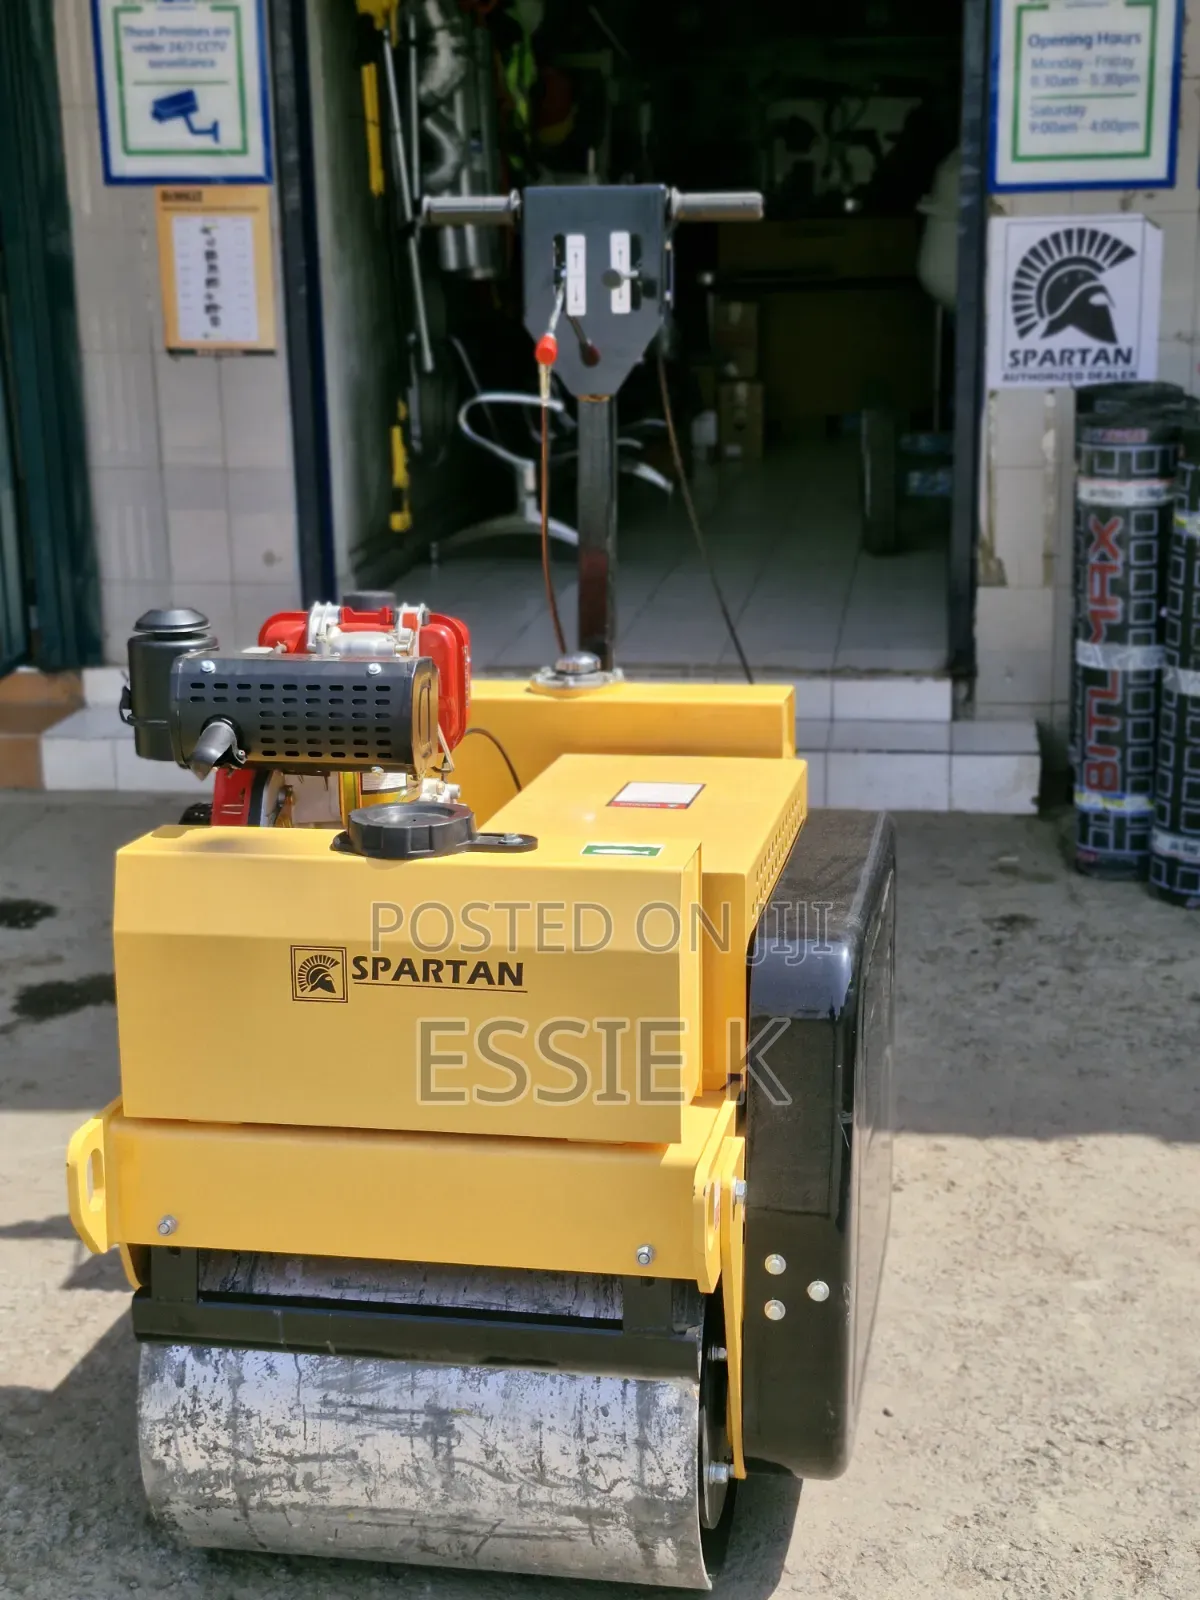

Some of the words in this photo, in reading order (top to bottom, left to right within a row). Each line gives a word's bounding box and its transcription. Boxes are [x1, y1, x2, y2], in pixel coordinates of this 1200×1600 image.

[1029, 34, 1093, 50] Opening
[1097, 32, 1141, 44] Hours
[1031, 58, 1083, 70] Monday
[1095, 56, 1135, 69] Friday
[1030, 104, 1086, 118] Saturday
[1008, 348, 1133, 367] SPARTAN
[1003, 370, 1085, 382] AUTHORIZED
[1088, 371, 1138, 380] DEALER
[352, 956, 524, 986] SPARTAN
